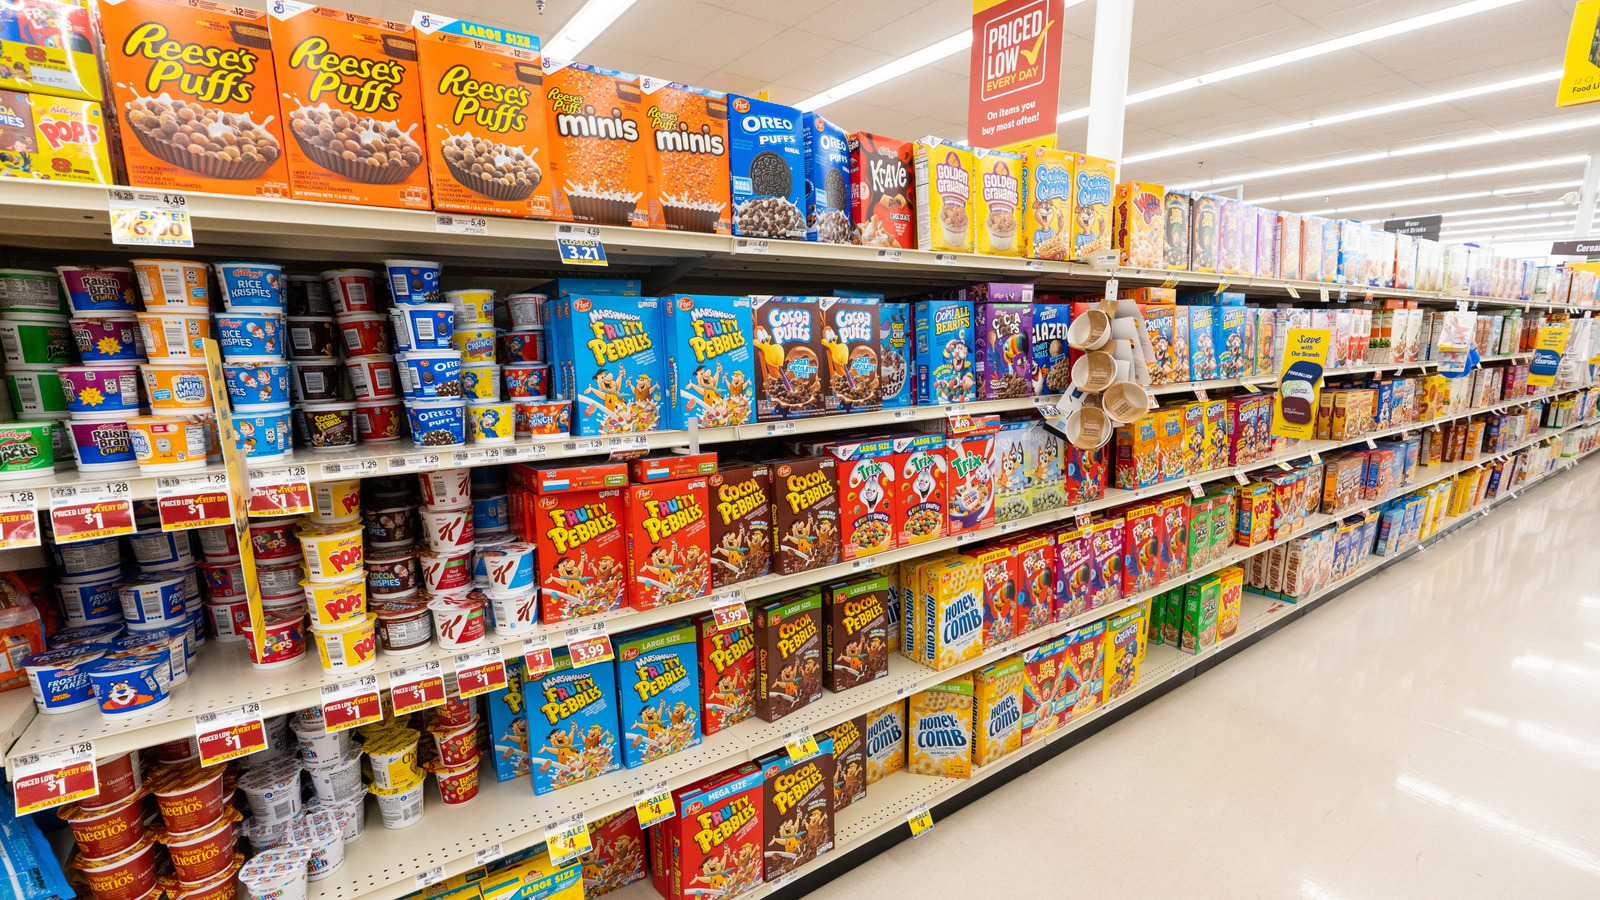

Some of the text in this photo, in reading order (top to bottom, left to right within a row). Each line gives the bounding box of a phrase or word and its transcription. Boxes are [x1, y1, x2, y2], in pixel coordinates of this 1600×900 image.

[462, 23, 530, 48] LARGE SIZE
[989, 10, 1042, 53] PRICED
[124, 22, 258, 73] Reese's
[290, 36, 406, 84] Reese's
[988, 45, 1019, 80] LOW
[148, 60, 254, 103] Puffs
[987, 66, 1039, 91] EVERY DAY
[308, 70, 401, 112] Puffs
[1572, 84, 1591, 93] Food
[987, 101, 1035, 120] On items you
[557, 105, 639, 142] minis
[742, 116, 793, 132] OREO
[982, 112, 1040, 135] buy most often!
[759, 135, 795, 145] PUFFS
[164, 196, 185, 205] 4.49
[561, 239, 599, 247] CLOSEOUT
[568, 247, 599, 260] 3.21
[82, 277, 119, 289] Raisin
[238, 280, 261, 289] RICE
[89, 286, 117, 296] Bran
[231, 288, 271, 298] KRISPIES
[90, 294, 119, 303] Crunch
[576, 301, 590, 310] Post
[588, 309, 641, 323] MARSHMALLOW
[955, 306, 970, 319] ALL
[936, 318, 969, 335] BERRIES
[992, 313, 1021, 329] COCOA
[997, 325, 1019, 339] LOOPS
[1297, 335, 1321, 344] Save
[177, 383, 203, 391] Mini
[315, 413, 337, 422] COCOA
[418, 409, 452, 422] OREO
[528, 415, 553, 428] CRUNCH
[315, 418, 342, 430] PEBBLES
[428, 418, 455, 427] PUFFS
[92, 430, 130, 440] Raisin
[635, 436, 646, 444] 4.89
[99, 439, 128, 449] Bran
[859, 444, 877, 452] LARGE
[100, 446, 129, 456] Crunch
[911, 453, 935, 473] Trix
[952, 451, 982, 479] Trix
[288, 467, 305, 476] 1.28
[858, 460, 882, 482] Trix
[56, 488, 76, 496] $7.31
[106, 483, 129, 493] 1.28
[718, 478, 759, 502] COCOA
[9, 492, 34, 503] 1.28
[78, 507, 91, 516] LOW
[85, 513, 104, 529] $1
[80, 531, 101, 539] SAVE
[252, 530, 283, 546] FROOT
[329, 545, 362, 573] POPS
[424, 562, 441, 585] K
[492, 560, 514, 585] K
[1221, 585, 1241, 610] POPS
[785, 602, 811, 615] LARGE SIZE
[593, 622, 605, 631] 4.89
[943, 608, 982, 645] COMB
[642, 634, 681, 650] LARGE SIZE
[579, 644, 605, 659] 3.99
[51, 678, 87, 693] FLAKES
[360, 677, 376, 686] 1.28
[241, 703, 260, 714] 1.28
[347, 705, 360, 719] $1
[917, 727, 967, 749] COMB
[69, 742, 92, 755] 1.28
[19, 755, 40, 764] $9.75
[16, 779, 40, 790] PRICED
[40, 773, 54, 784] LOW
[81, 764, 92, 773] DAY
[47, 780, 66, 795] $1
[708, 781, 747, 802] MEGA SIZE
[41, 798, 61, 808] SAVE
[647, 792, 670, 806] SALE!
[650, 803, 662, 816] $4
[571, 813, 584, 822] 5.49
[84, 816, 122, 833] Honey Nut
[73, 821, 128, 842] Cheerios
[559, 825, 585, 840] SALE!
[202, 842, 216, 850] Nut
[563, 838, 576, 850] $4
[171, 846, 220, 866] Cheerios
[521, 869, 575, 898] LARGE SIZE
